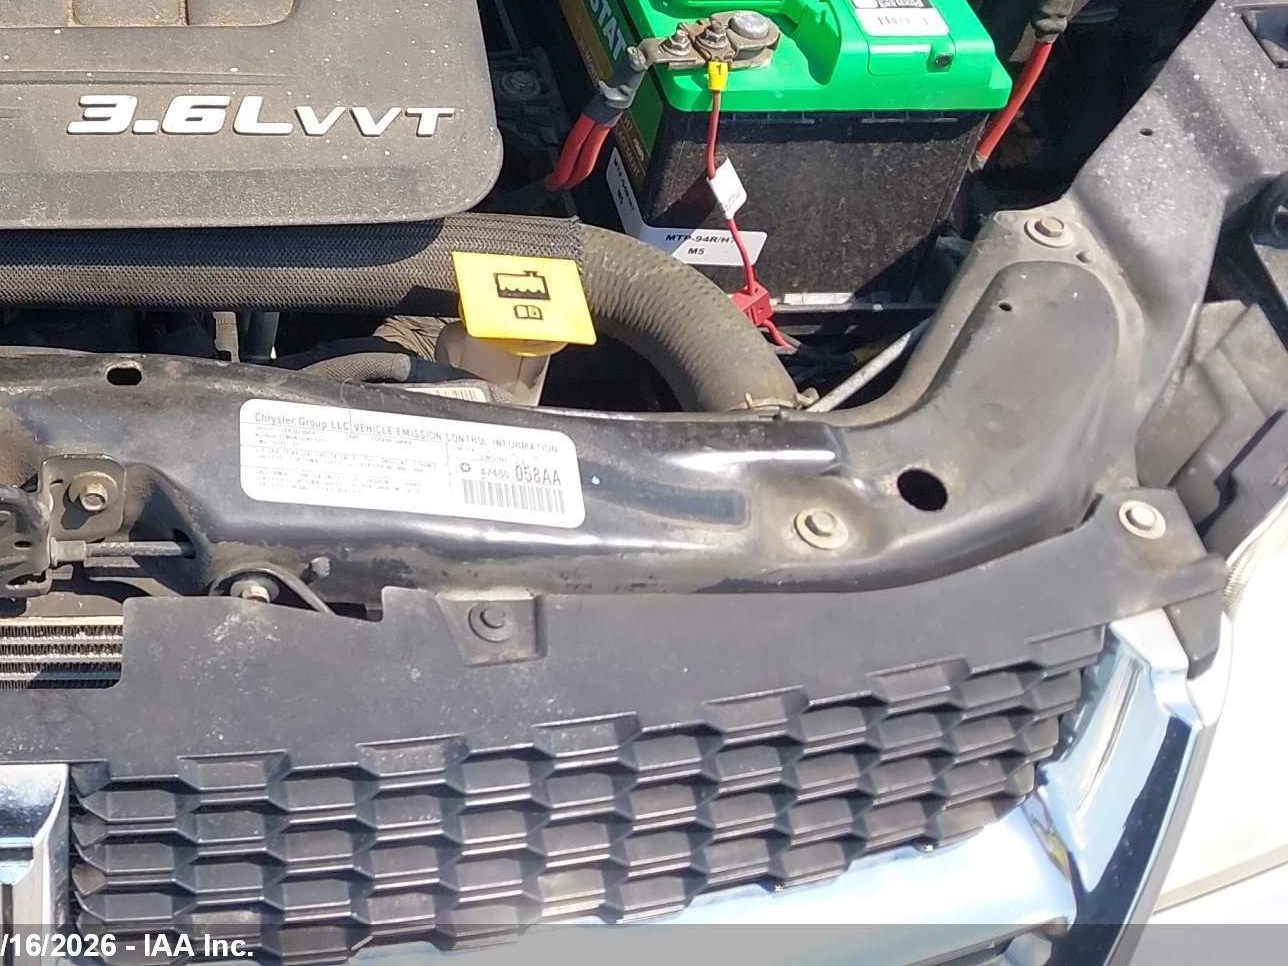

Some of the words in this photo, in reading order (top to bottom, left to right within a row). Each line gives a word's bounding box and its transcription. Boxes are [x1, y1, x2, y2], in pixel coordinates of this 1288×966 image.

[688, 247, 706, 255] M5
[254, 412, 295, 427] Chrysler
[298, 416, 329, 432] Group
[331, 418, 349, 431] LLC
[354, 423, 393, 436] VEHICLE
[396, 427, 442, 441] EMISSION
[445, 433, 487, 446] CONTROL
[492, 438, 559, 453] INFORMATION
[515, 464, 562, 484] 058AA
